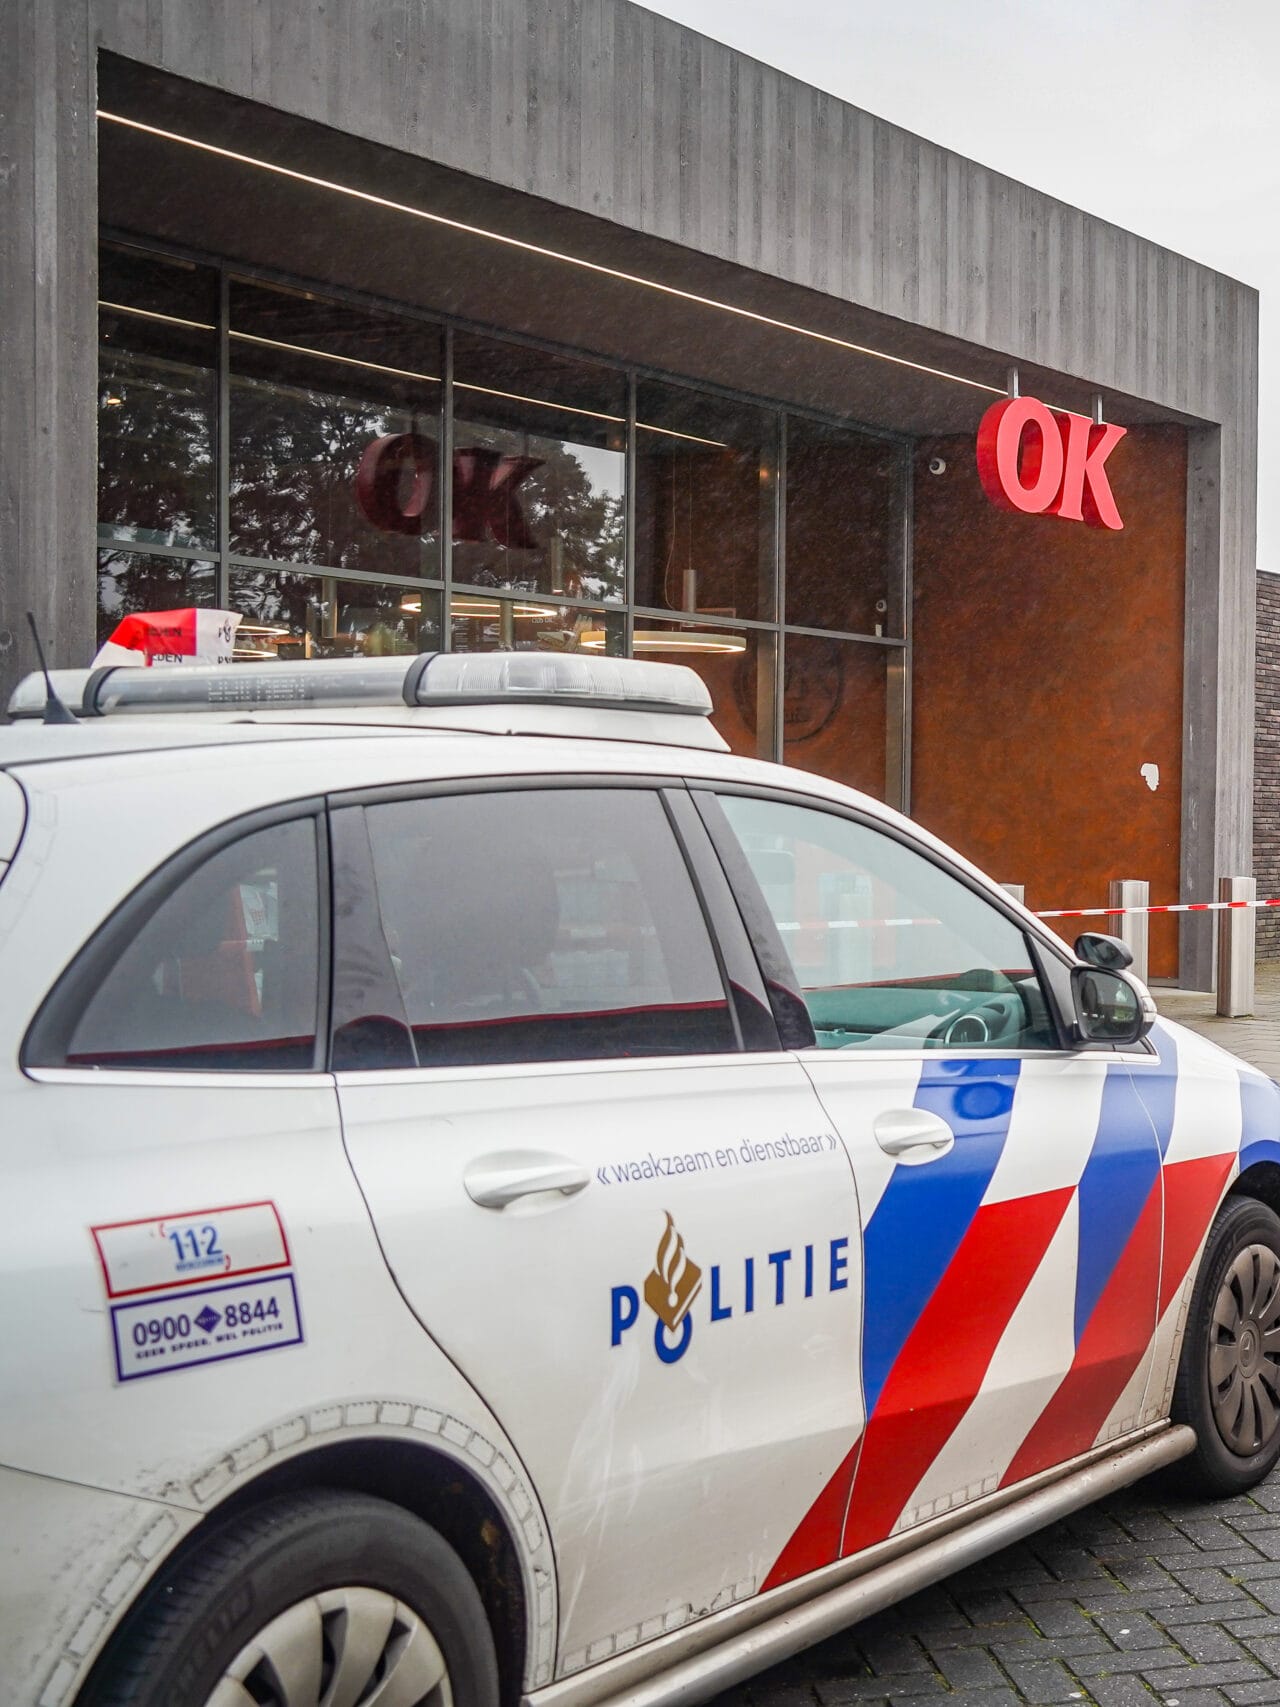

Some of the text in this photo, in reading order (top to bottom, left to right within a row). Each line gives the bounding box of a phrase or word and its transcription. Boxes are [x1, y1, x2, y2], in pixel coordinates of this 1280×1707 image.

[977, 397, 1127, 530] OK
[611, 1152, 715, 1184] waakzaam
[717, 1147, 740, 1167] en
[739, 1132, 825, 1164] dienstbaar
[133, 1296, 279, 1347] 0900 8844
[610, 1237, 849, 1364] POLITIE
[242, 1322, 283, 1338] POLITIE
